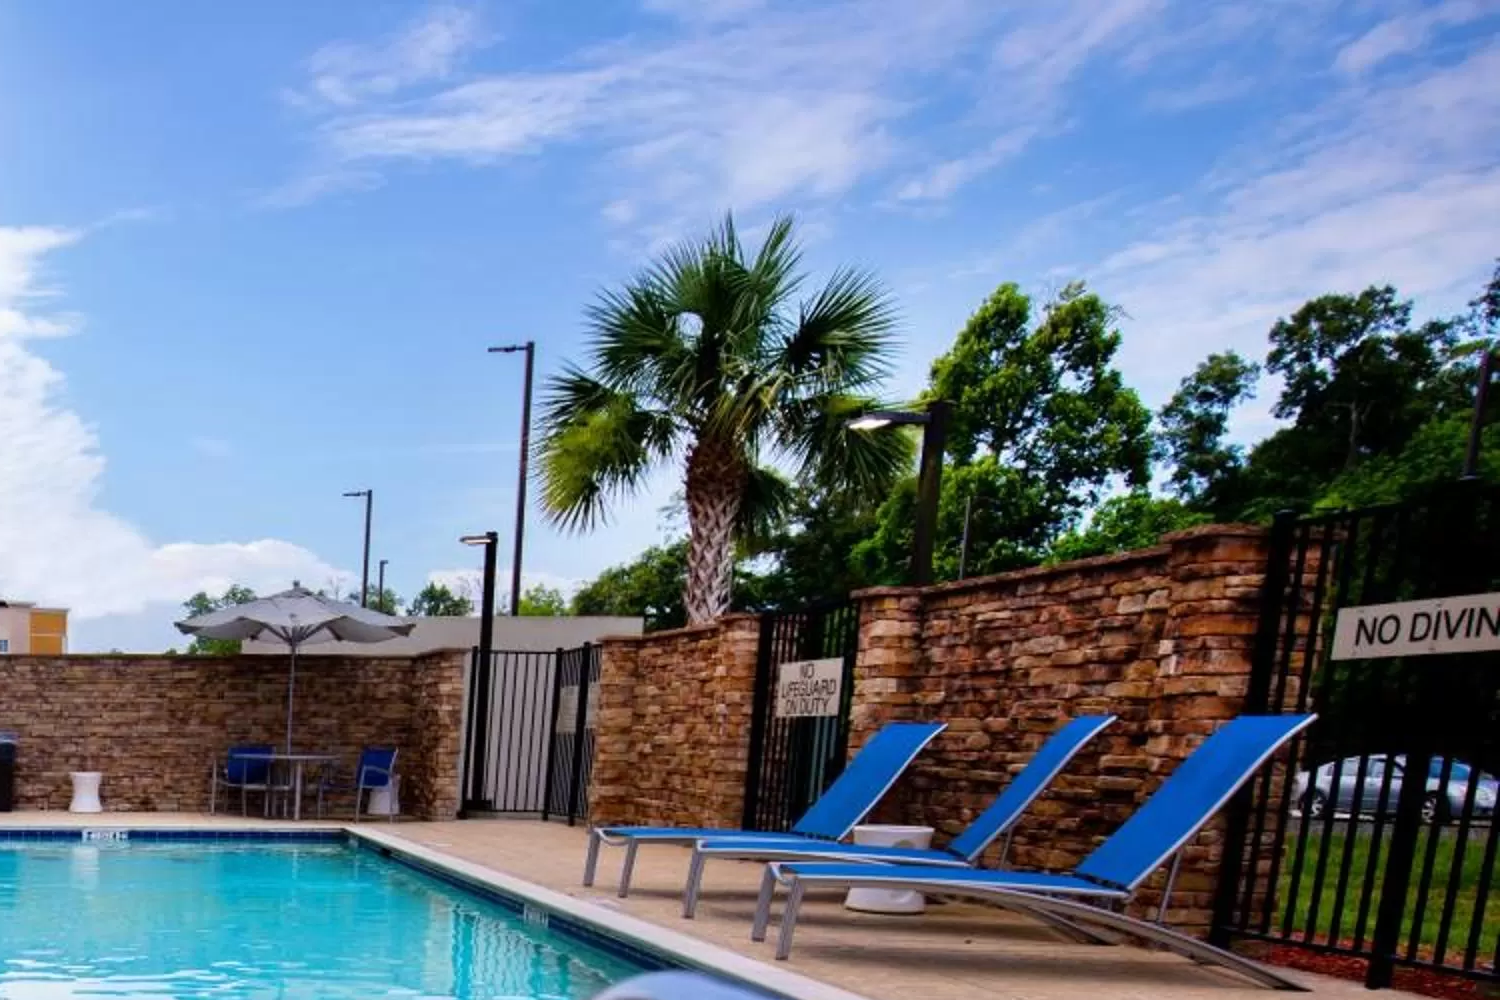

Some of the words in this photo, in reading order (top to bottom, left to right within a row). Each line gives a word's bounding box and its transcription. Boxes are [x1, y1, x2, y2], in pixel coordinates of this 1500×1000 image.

[1355, 614, 1400, 646] NO
[1409, 607, 1500, 642] DIVIN
[800, 663, 815, 679] NO
[800, 697, 831, 715] DUTY
